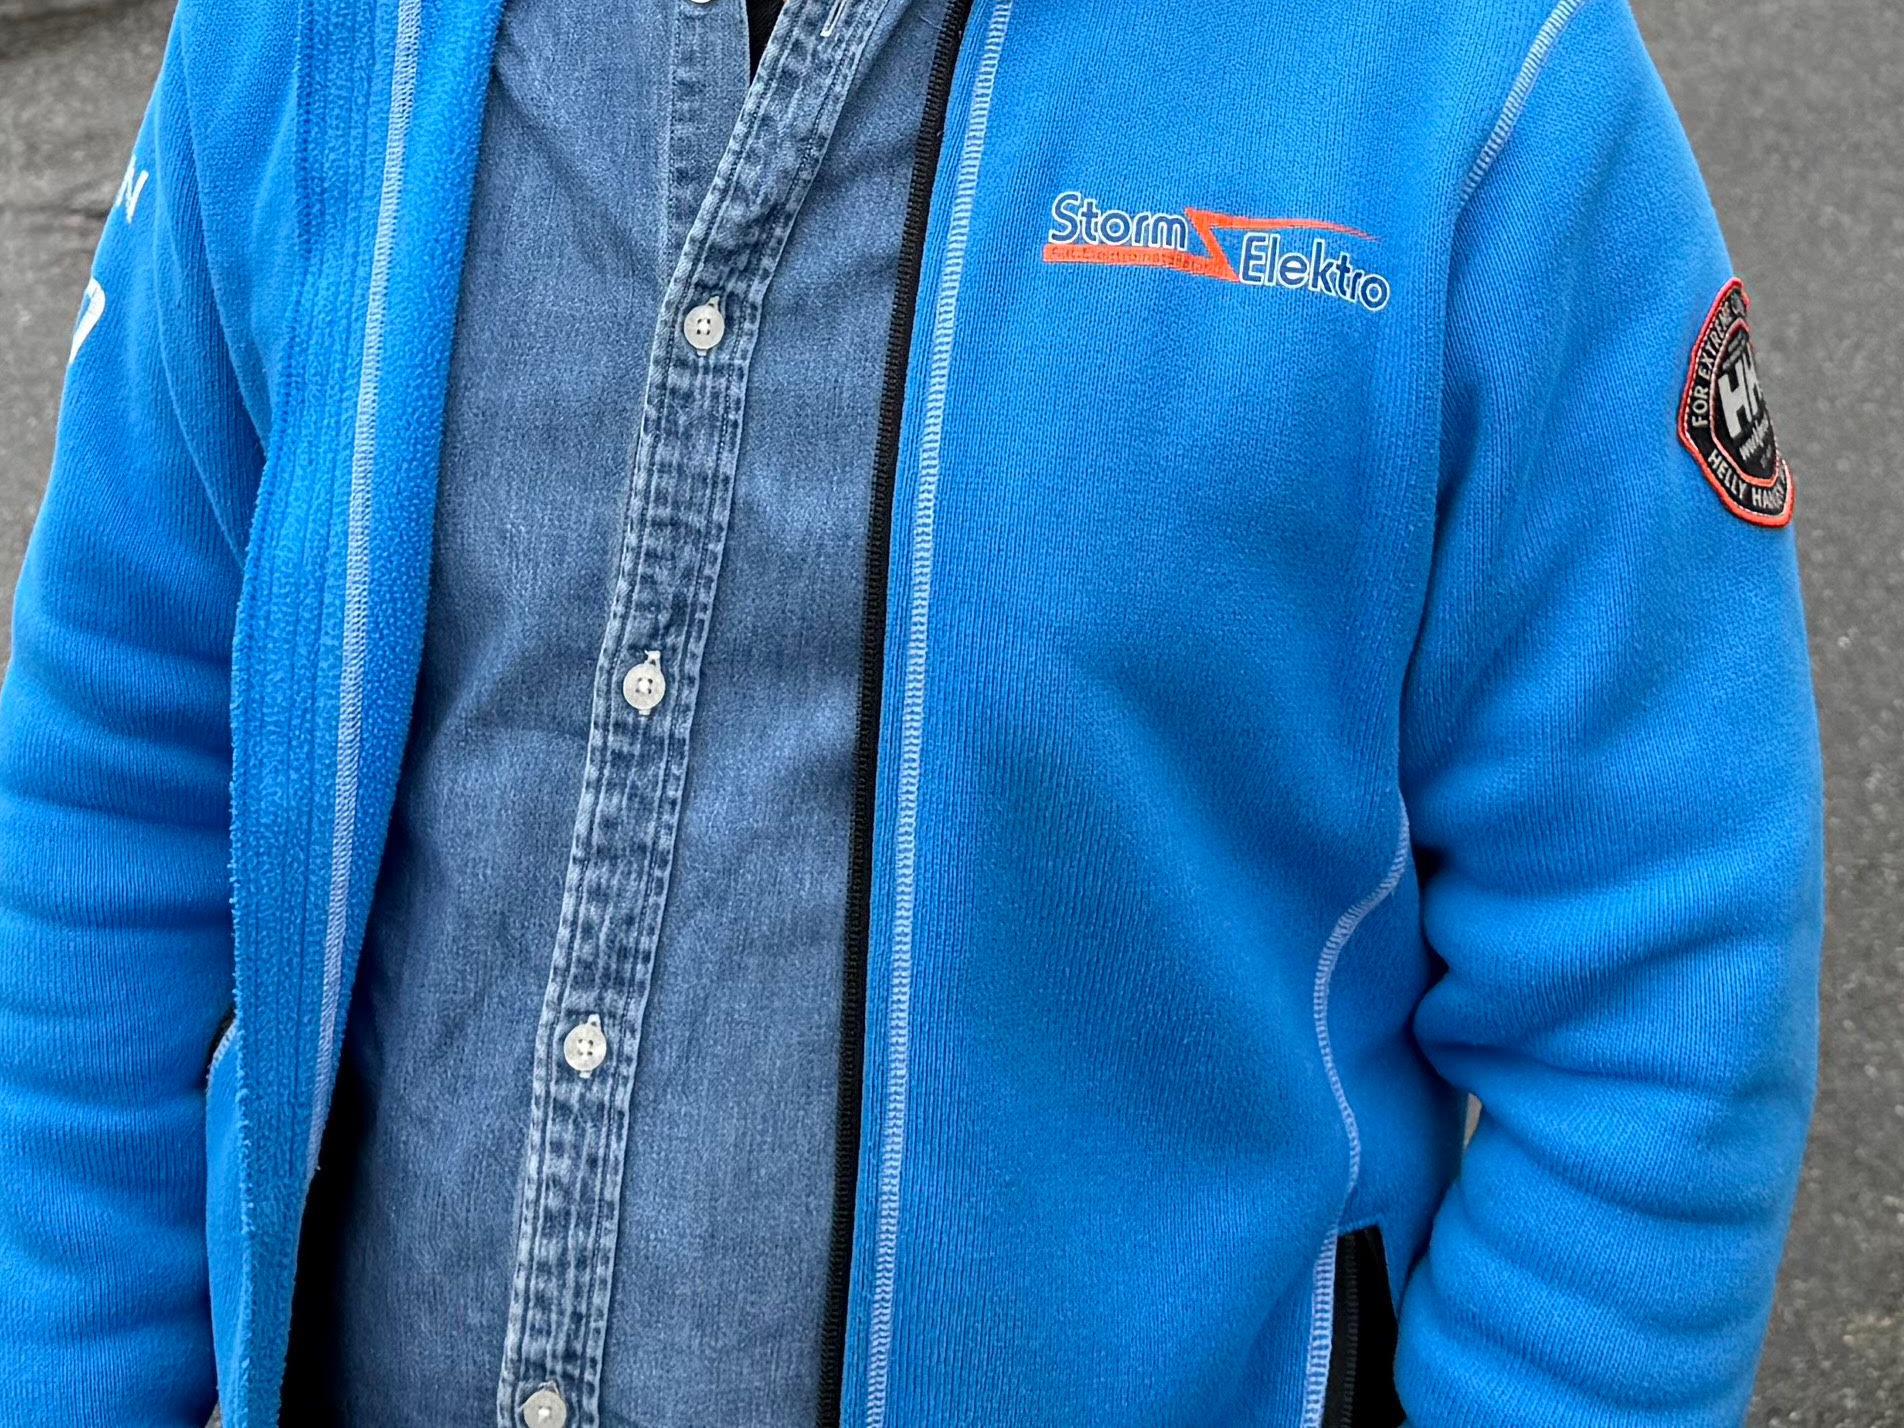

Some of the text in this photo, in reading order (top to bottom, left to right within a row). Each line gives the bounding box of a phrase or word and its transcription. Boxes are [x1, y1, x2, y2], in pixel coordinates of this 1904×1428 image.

[1049, 191, 1390, 312] Storm Elektro
[1691, 385, 1709, 428] FOR
[1707, 447, 1748, 500] HELLY
